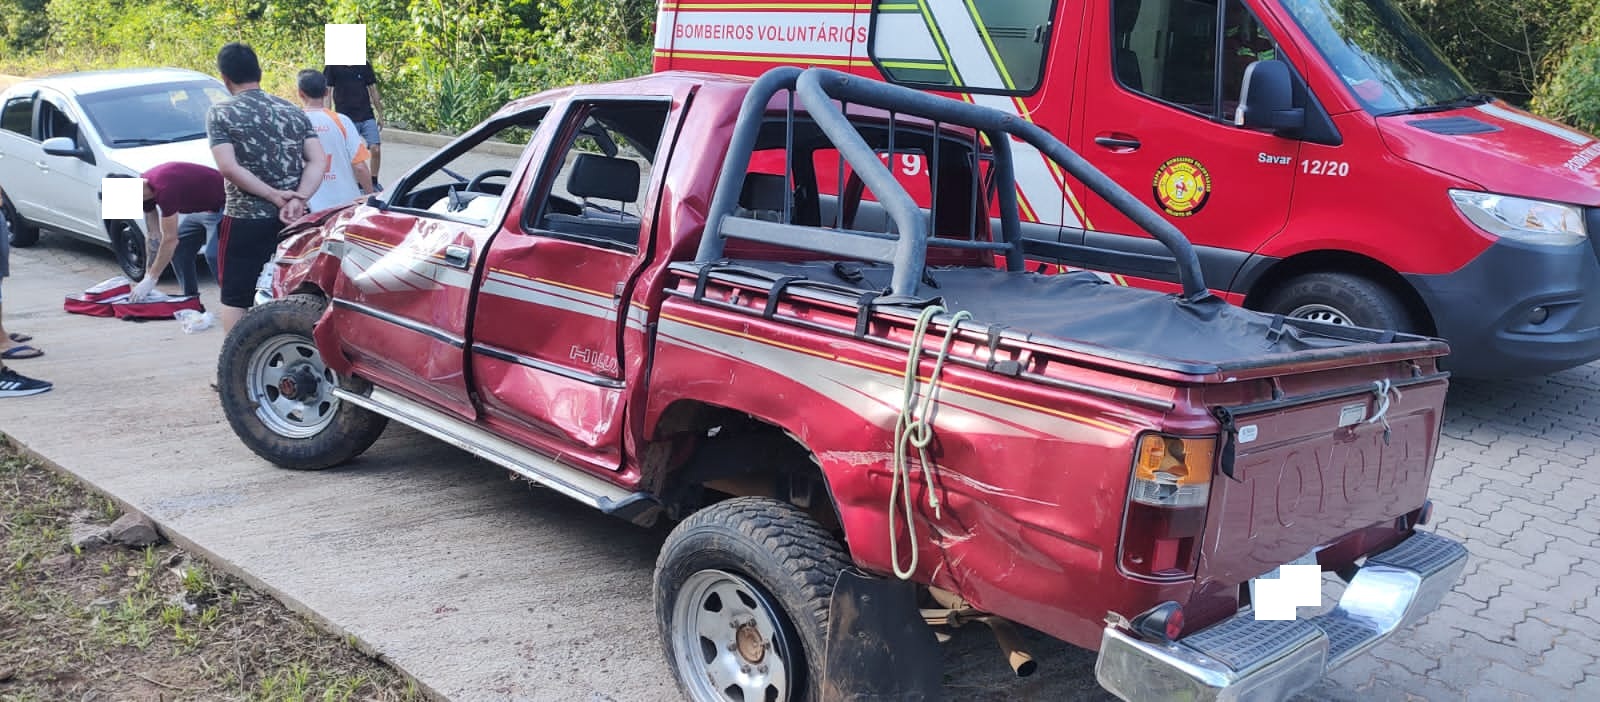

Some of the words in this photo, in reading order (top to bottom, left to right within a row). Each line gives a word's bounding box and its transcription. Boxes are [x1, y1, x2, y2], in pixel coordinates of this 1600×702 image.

[675, 23, 754, 40] BOMBEIROS
[757, 21, 867, 43] VOLUNTÁRIOS
[1258, 152, 1292, 165] Savar
[1301, 159, 1350, 177] 12/20
